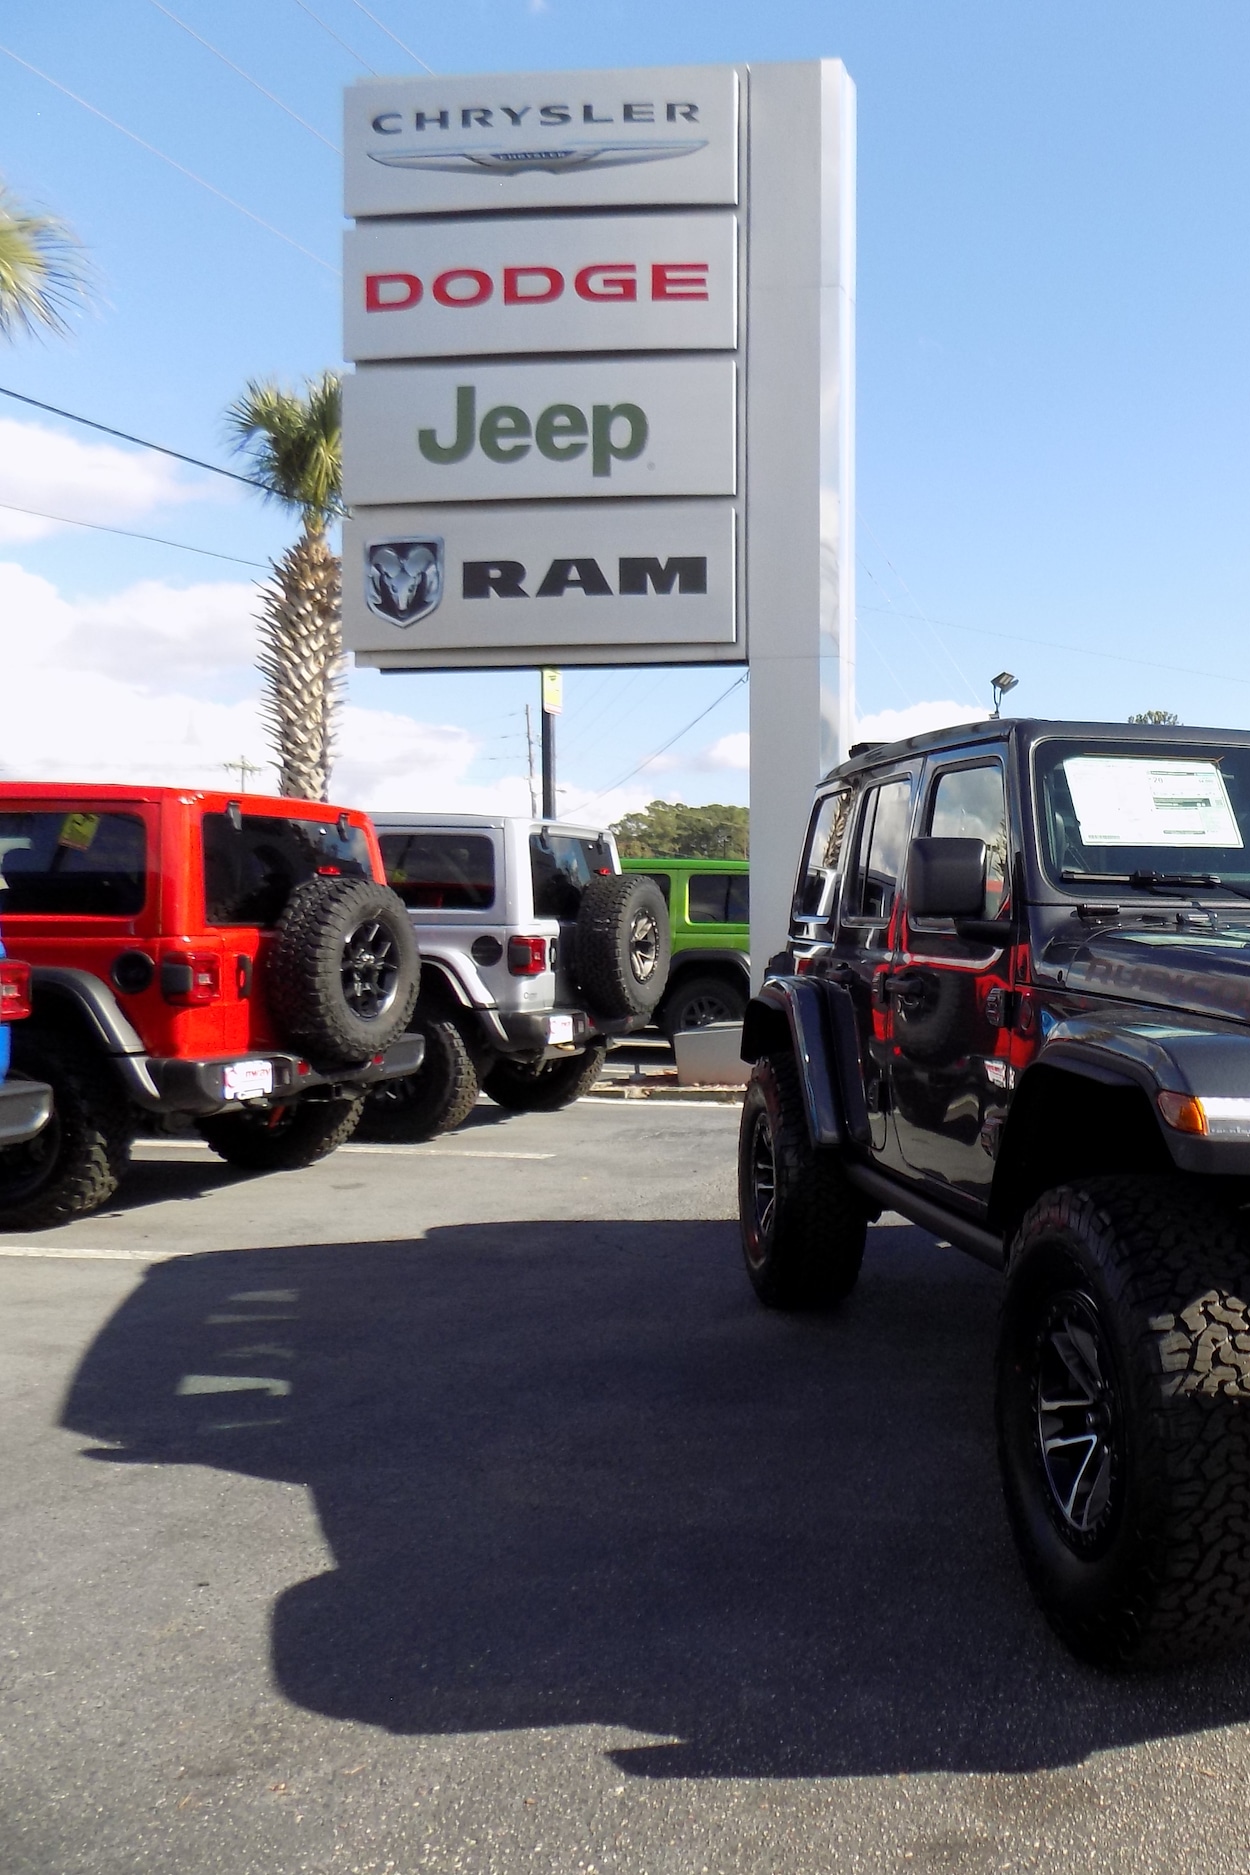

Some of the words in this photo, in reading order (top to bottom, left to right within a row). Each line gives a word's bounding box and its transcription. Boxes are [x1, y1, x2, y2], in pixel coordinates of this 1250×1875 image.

[372, 102, 700, 135] CHRYSLER
[366, 264, 709, 313] DODGE
[418, 385, 648, 477] Jeep
[462, 556, 708, 599] RAM
